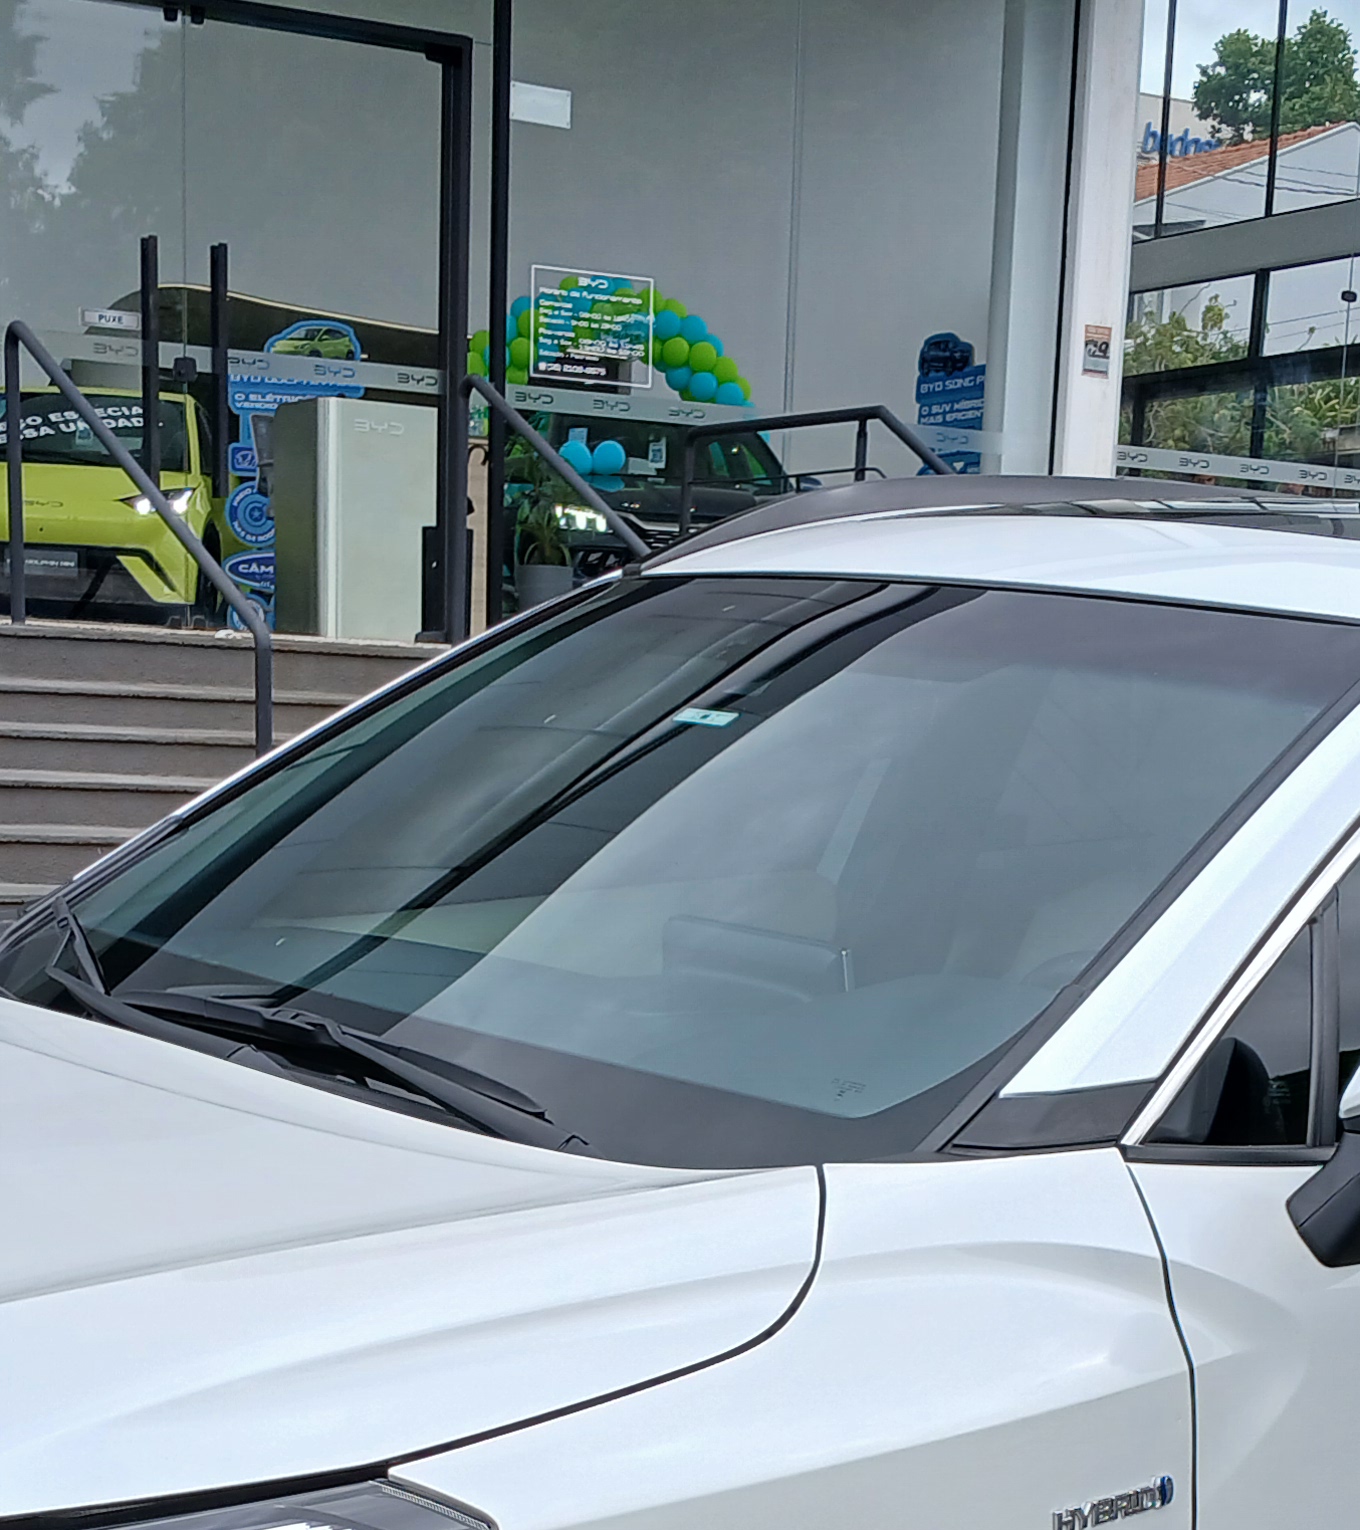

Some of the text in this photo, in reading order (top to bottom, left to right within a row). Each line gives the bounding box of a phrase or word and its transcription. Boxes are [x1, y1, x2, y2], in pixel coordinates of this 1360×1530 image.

[97, 313, 125, 326] PUXE
[313, 363, 357, 379] BYD
[396, 372, 439, 388] BYD
[920, 375, 985, 394] BYD SONG P
[514, 391, 554, 405] BYD
[592, 399, 631, 412] BYD
[48, 406, 144, 423] ESECIA
[667, 406, 706, 419] BYD
[354, 418, 405, 435] BYD
[1117, 450, 1149, 463] BYD
[1179, 456, 1211, 469] BYD
[1239, 463, 1270, 475] BYD
[1298, 469, 1328, 481] BYD
[238, 562, 275, 575] CÂM
